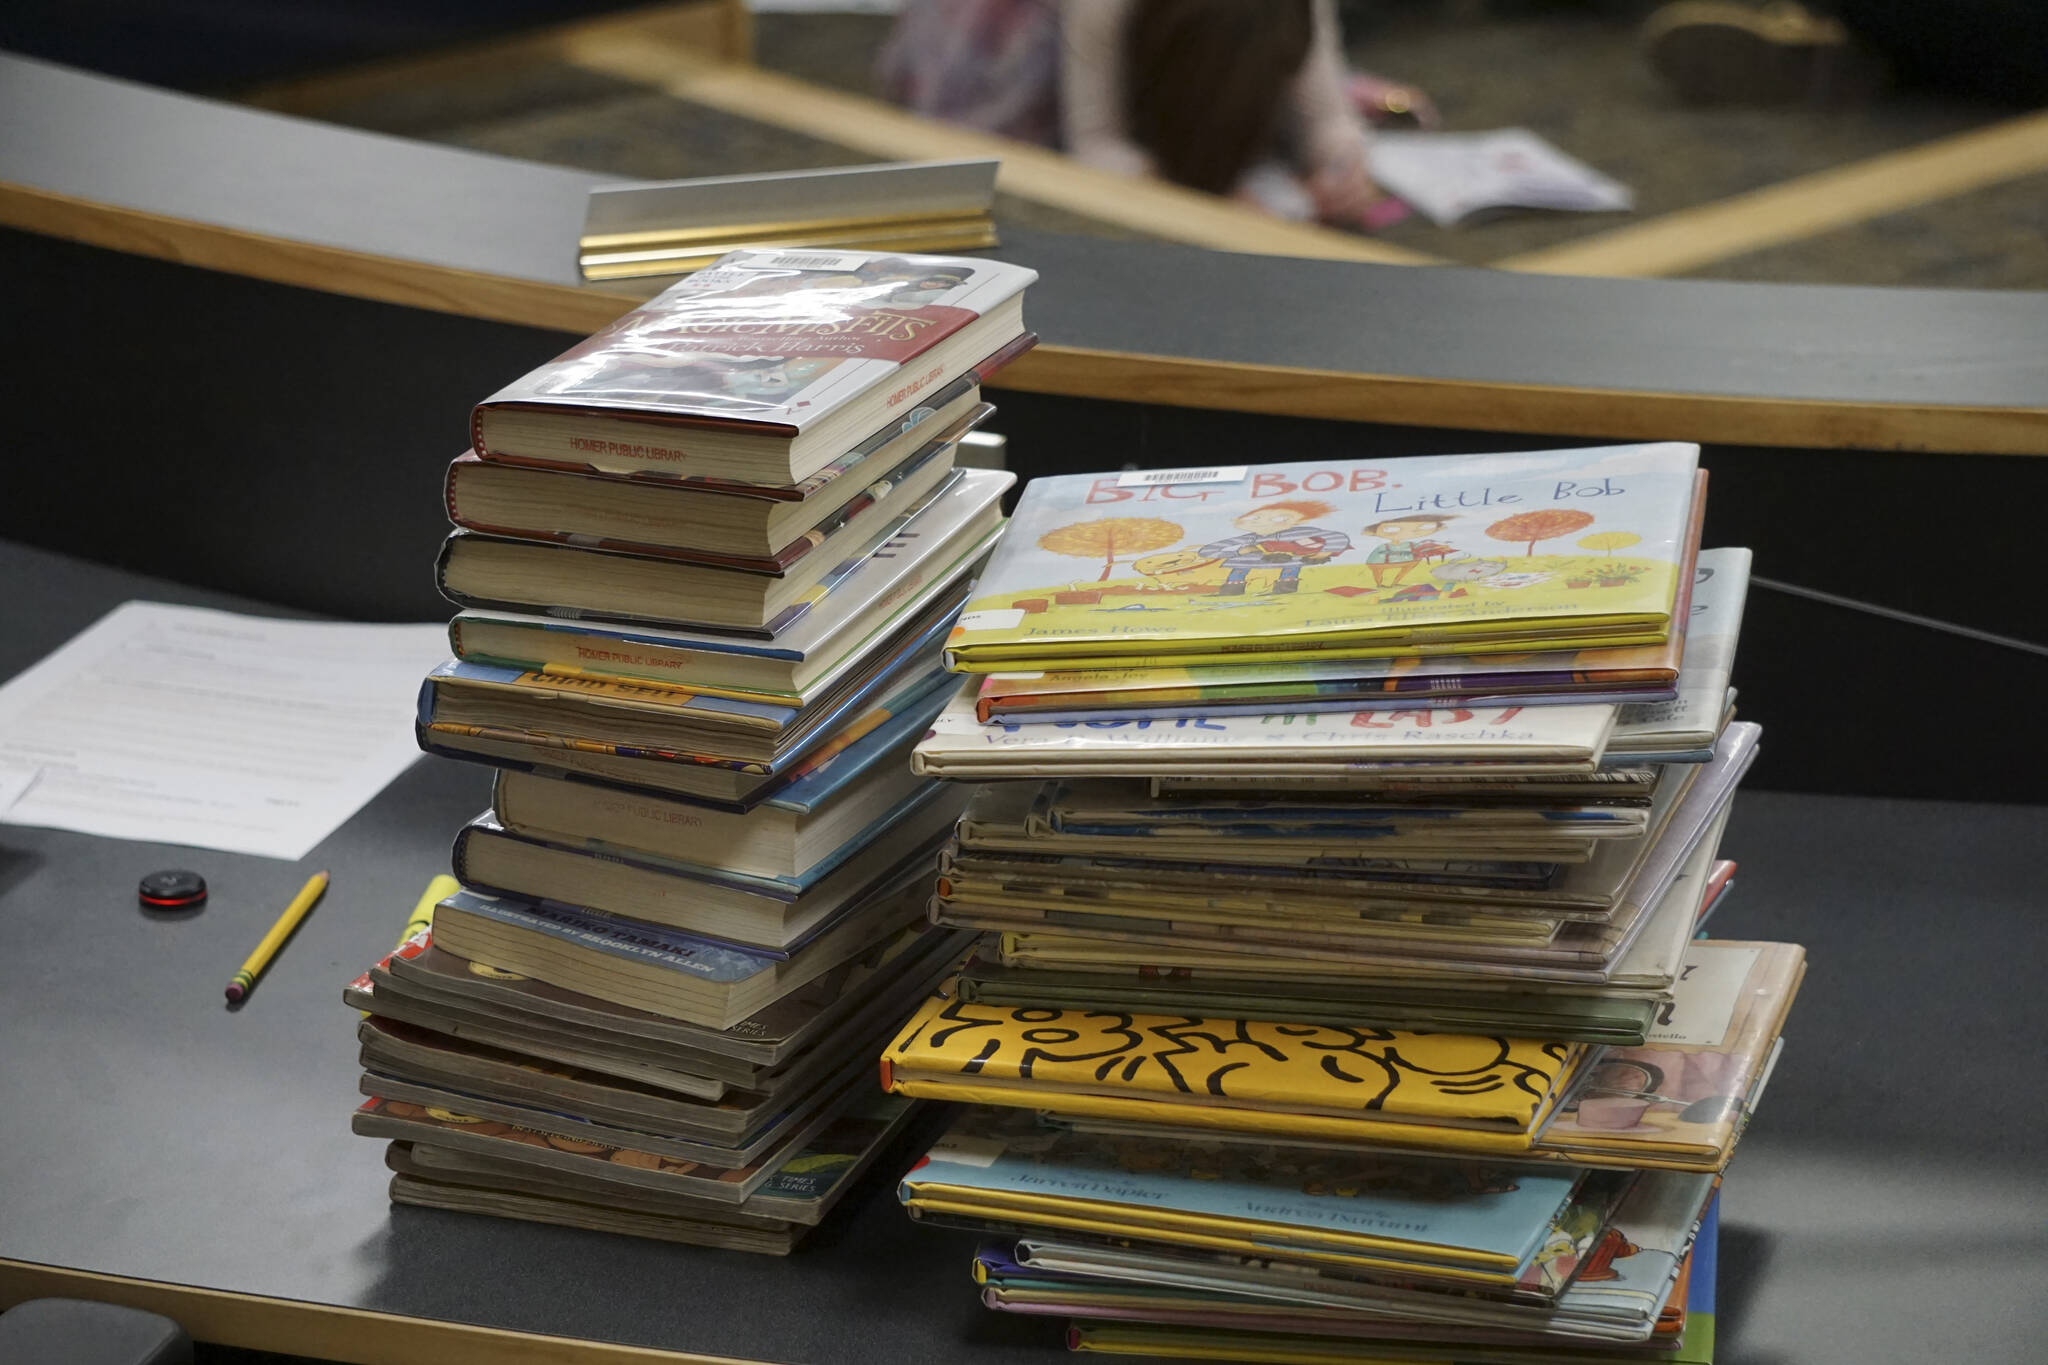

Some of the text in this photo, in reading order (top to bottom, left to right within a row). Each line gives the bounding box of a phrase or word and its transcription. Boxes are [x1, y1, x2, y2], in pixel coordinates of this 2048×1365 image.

[772, 341, 867, 354] Harris
[569, 437, 688, 463] HOMER PUBLIC LIBRARY
[1374, 478, 1626, 514] Little Bob
[1023, 624, 1178, 637] James Howe
[577, 646, 684, 670] HOMER PUBLIC LIBRARY
[1301, 731, 1389, 742] Chris
[1402, 729, 1535, 741] Raschka
[479, 904, 563, 932] ILLUSTRATED
[561, 927, 581, 936] BY
[579, 932, 663, 959] BROOKLYN
[661, 954, 717, 973] ALLEN
[610, 930, 696, 958] TAMAKI
[778, 1182, 817, 1193] SERIES
